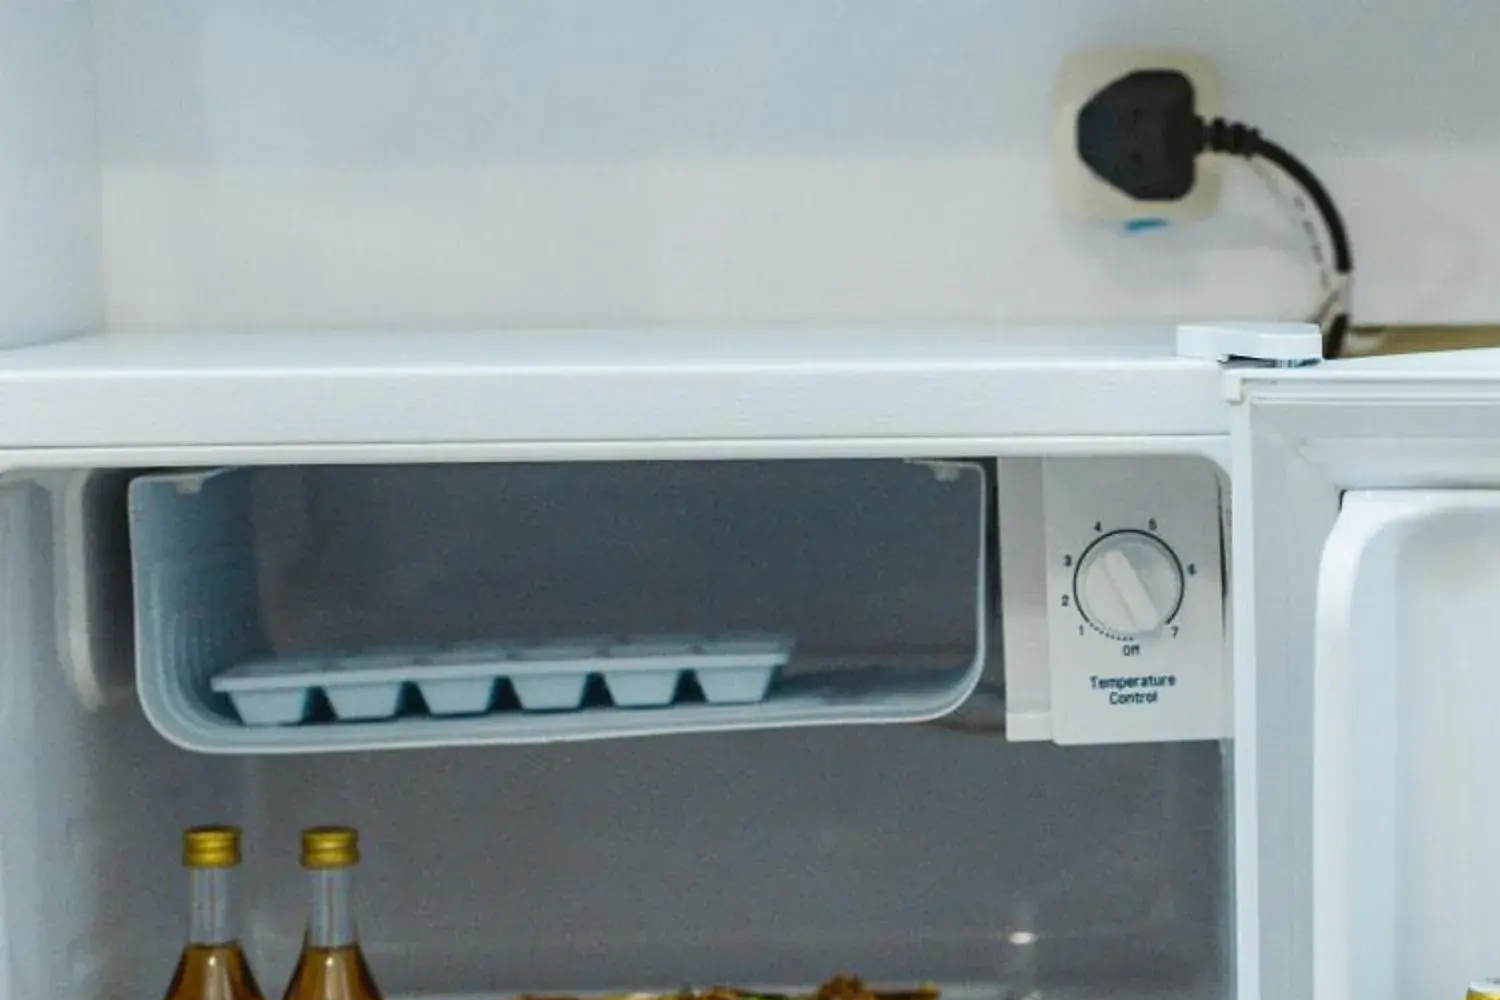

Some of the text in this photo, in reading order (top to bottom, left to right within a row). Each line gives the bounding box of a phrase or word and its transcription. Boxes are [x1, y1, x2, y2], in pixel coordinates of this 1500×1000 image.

[1061, 595, 1070, 607] 2
[1171, 626, 1180, 638] 7
[1122, 644, 1141, 656] Off
[1089, 674, 1176, 690] Temperature
[1109, 691, 1158, 705] Control
